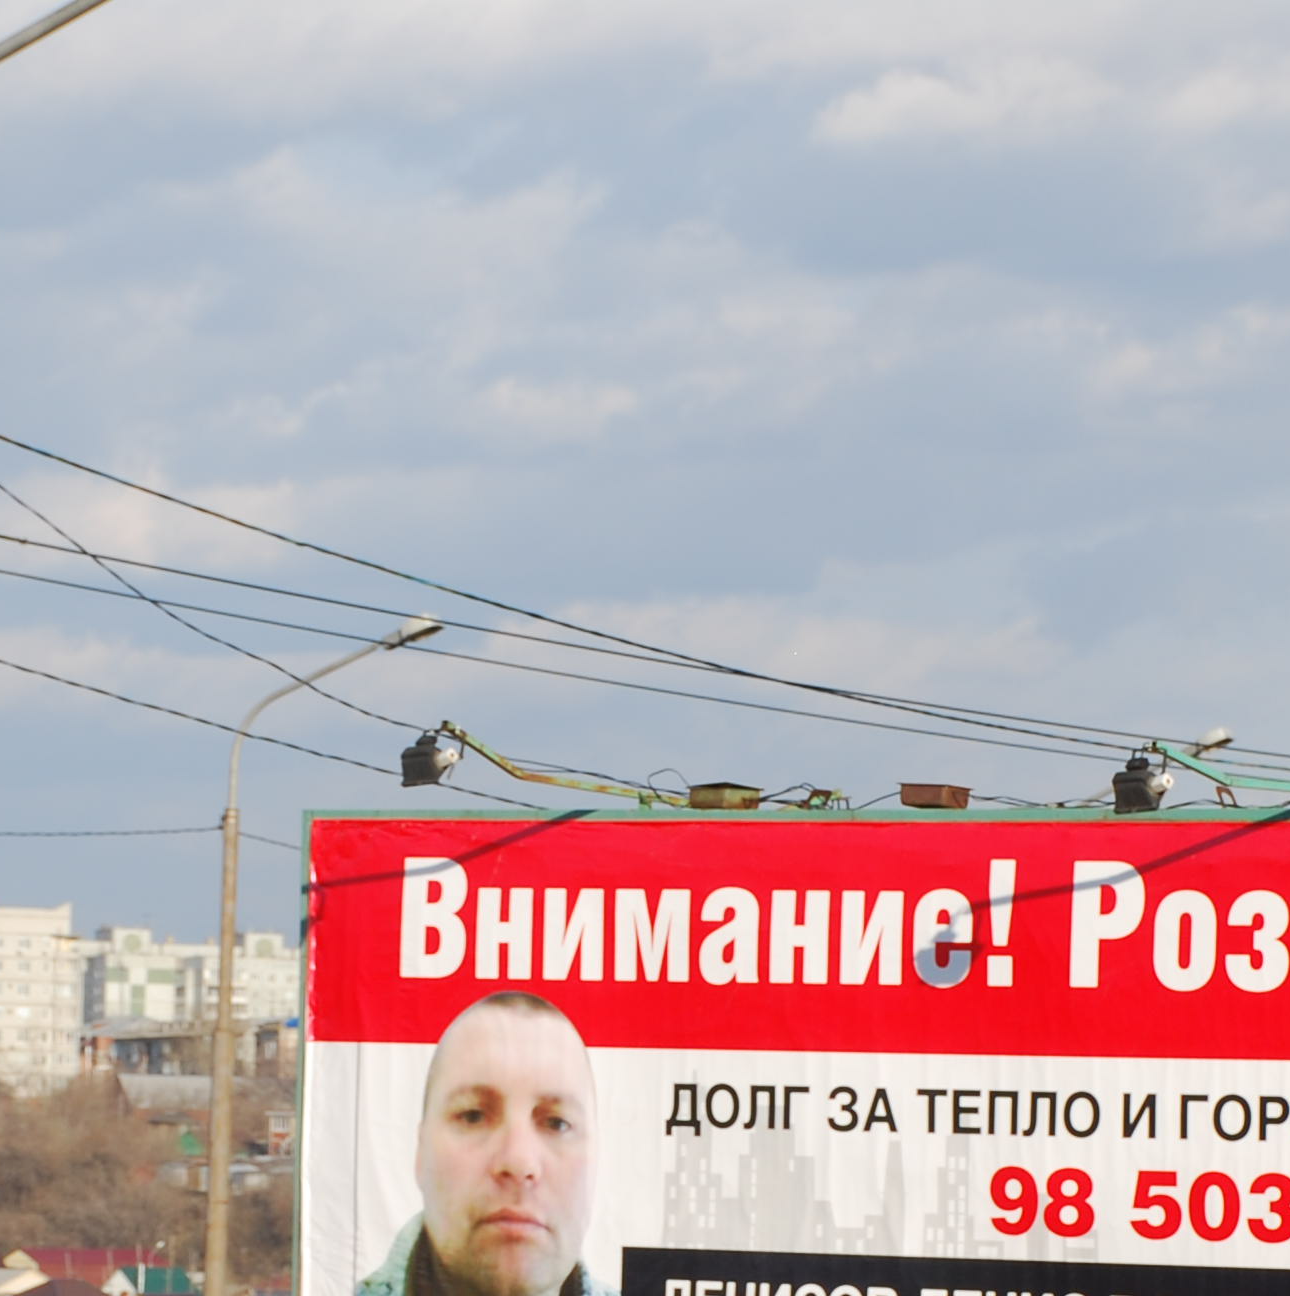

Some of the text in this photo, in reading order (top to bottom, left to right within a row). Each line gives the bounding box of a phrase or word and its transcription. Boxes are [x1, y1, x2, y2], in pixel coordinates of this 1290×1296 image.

[399, 856, 1018, 989] Внимание!
[665, 1082, 810, 1136] ДОЛГ
[827, 1087, 897, 1132] ЗА
[917, 1088, 1102, 1138] ТЕПЛО
[1121, 1093, 1158, 1138] И
[989, 1166, 1095, 1237] 98
